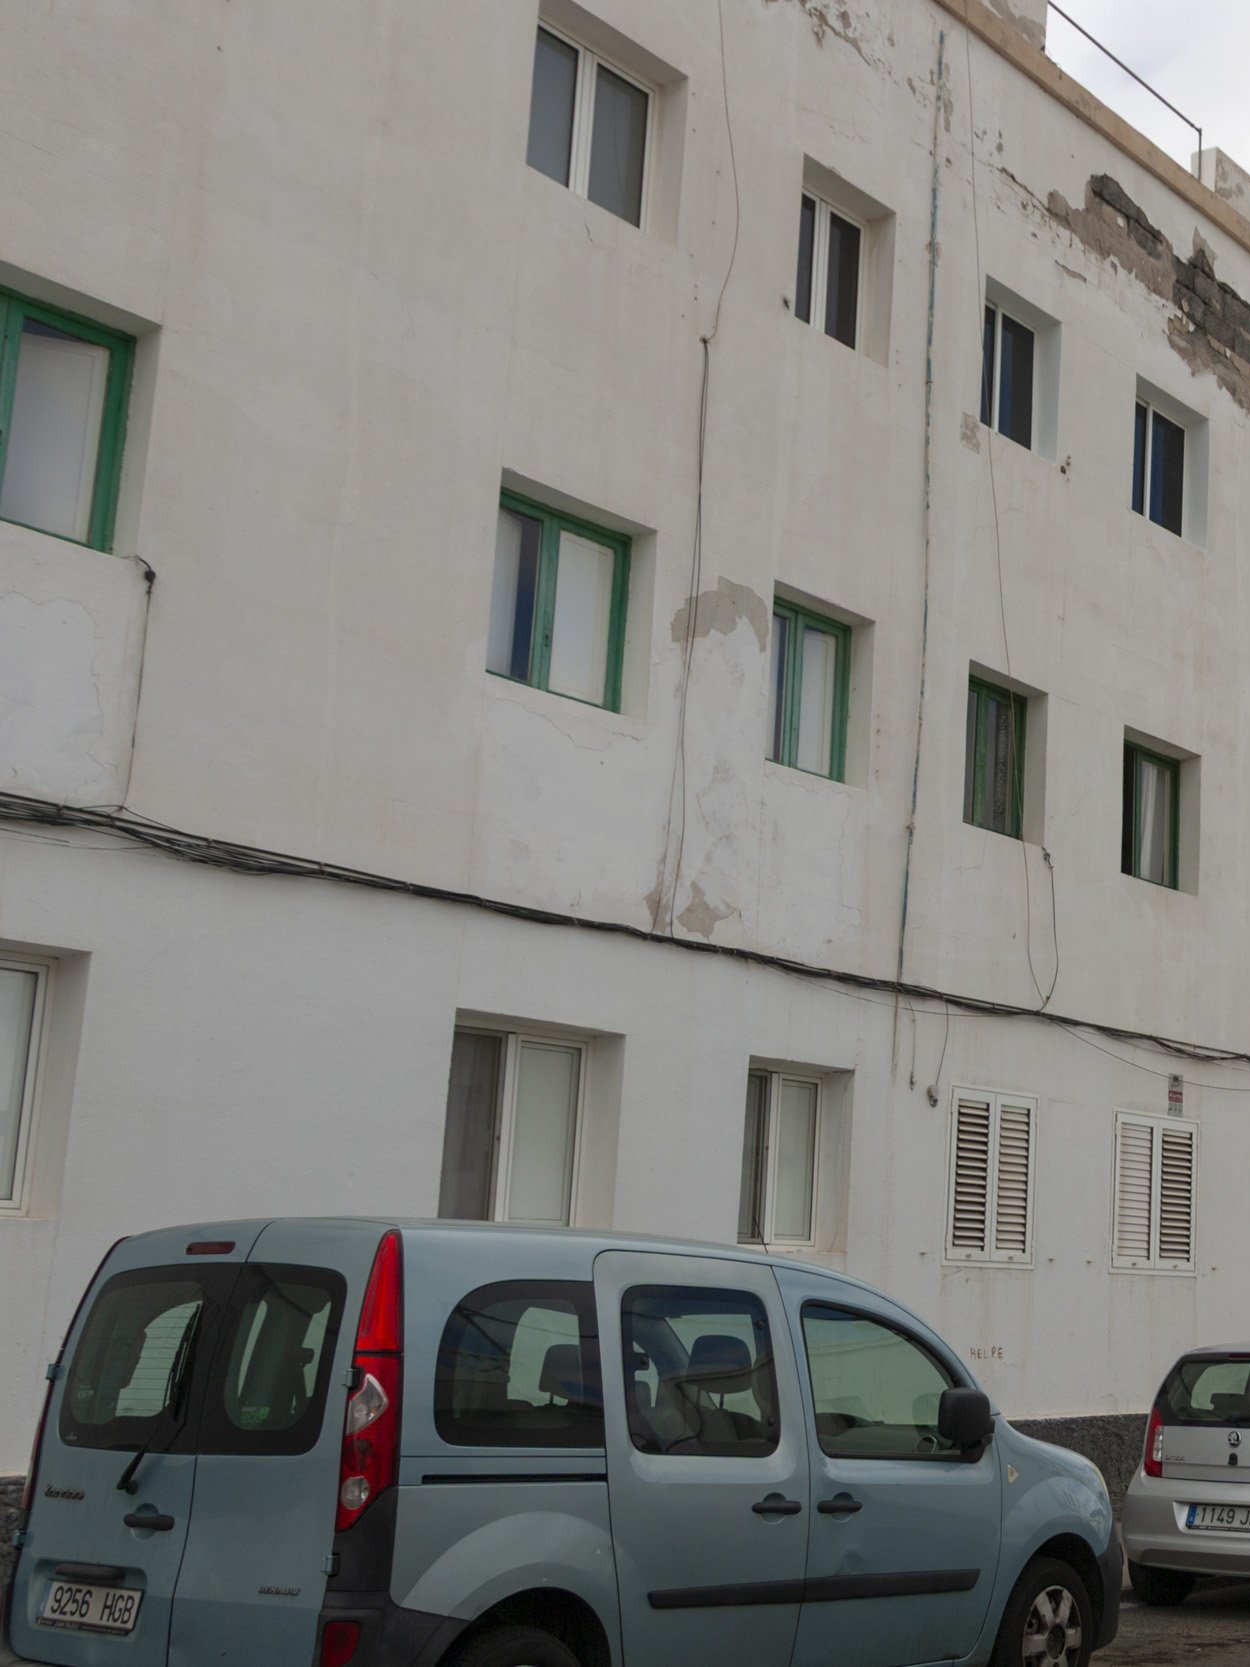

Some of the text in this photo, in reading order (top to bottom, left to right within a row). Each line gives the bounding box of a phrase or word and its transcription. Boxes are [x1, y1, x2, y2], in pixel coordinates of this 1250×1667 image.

[1200, 1507, 1235, 1525] 1149
[50, 1585, 135, 1624] 9256 HGB
